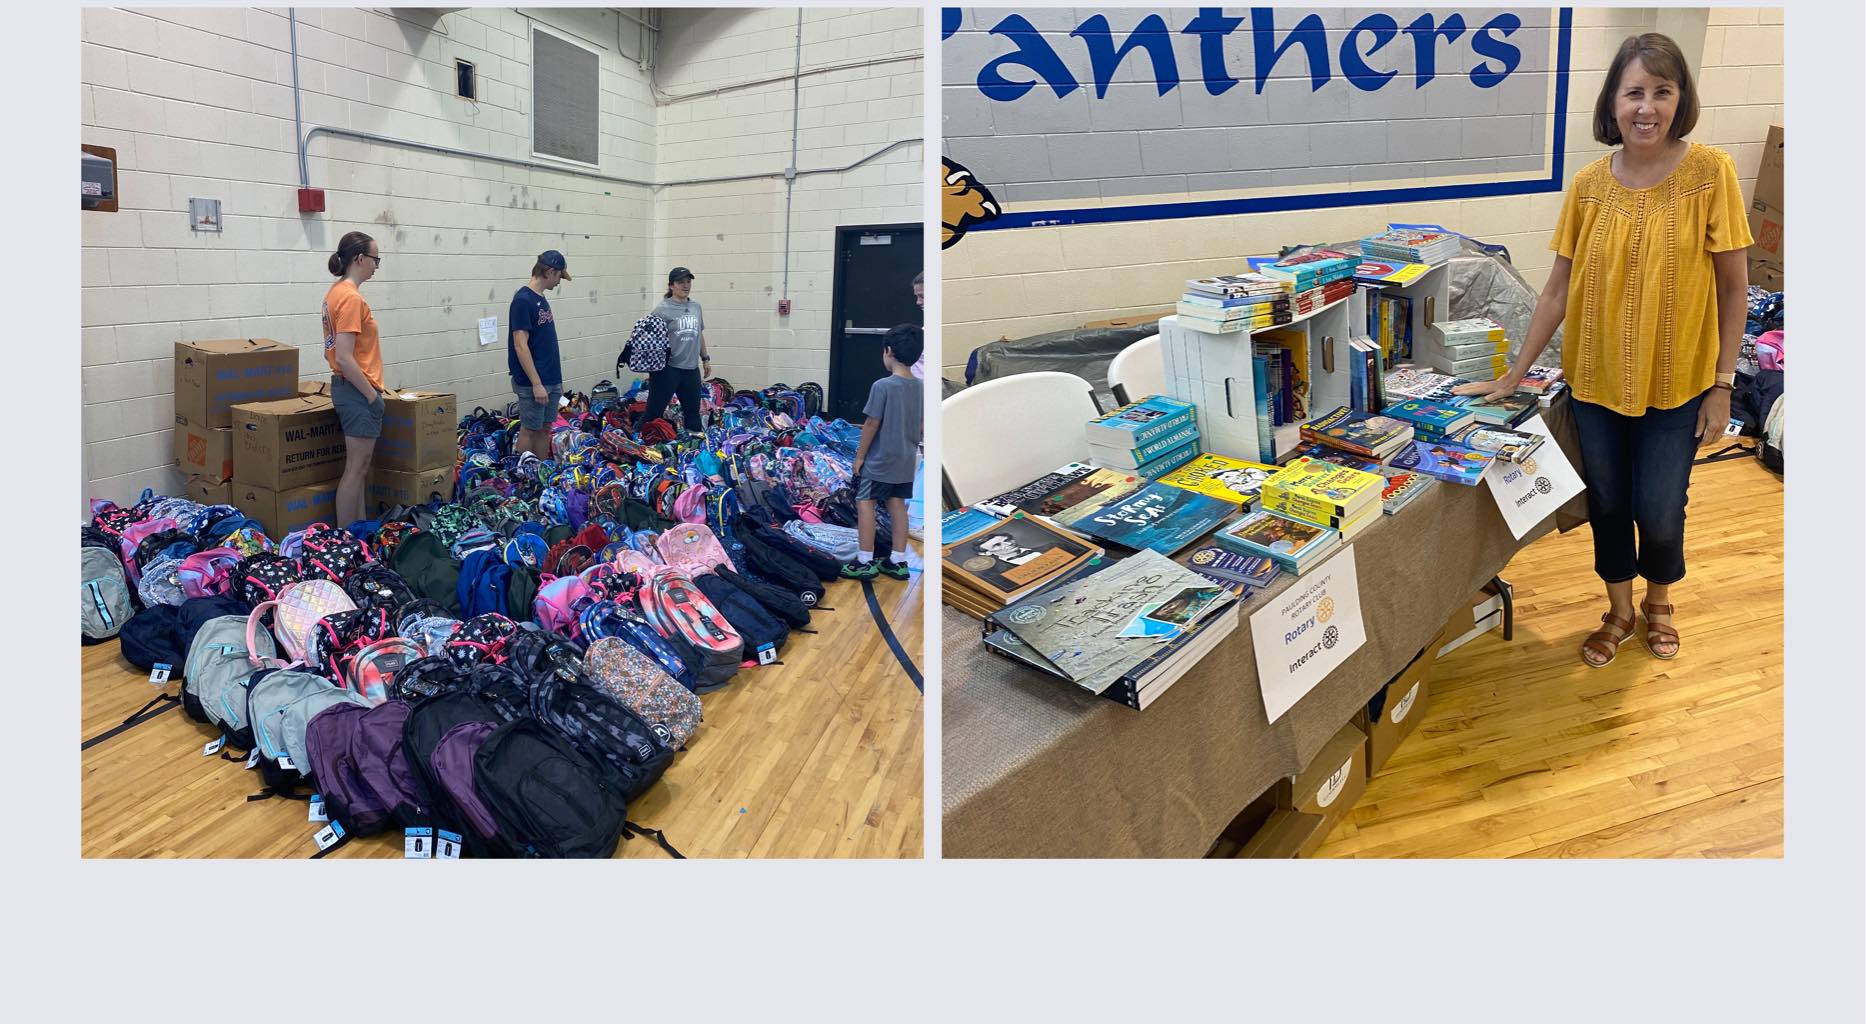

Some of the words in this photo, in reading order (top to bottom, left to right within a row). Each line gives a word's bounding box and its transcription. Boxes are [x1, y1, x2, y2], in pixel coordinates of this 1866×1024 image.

[942, 8, 1521, 101] anthers
[285, 424, 334, 443] WAL-MART
[1147, 439, 1167, 455] WORLD
[1167, 428, 1193, 444] ALMANAC
[286, 451, 315, 465] RETURN
[316, 448, 330, 457] FOR
[1177, 459, 1228, 487] CHOKED
[1290, 474, 1315, 487] Merci
[1316, 469, 1350, 489] Changes
[1337, 471, 1361, 484] Gears
[1503, 468, 1523, 485] Rotary
[1515, 488, 1538, 508] Interact
[1281, 590, 1309, 616] PAULDING
[1309, 574, 1332, 594] COUNTY
[1291, 601, 1312, 619] ROTARY
[1312, 589, 1327, 603] CLUB
[1285, 615, 1316, 645] Rotary
[1289, 642, 1322, 674] Interact
